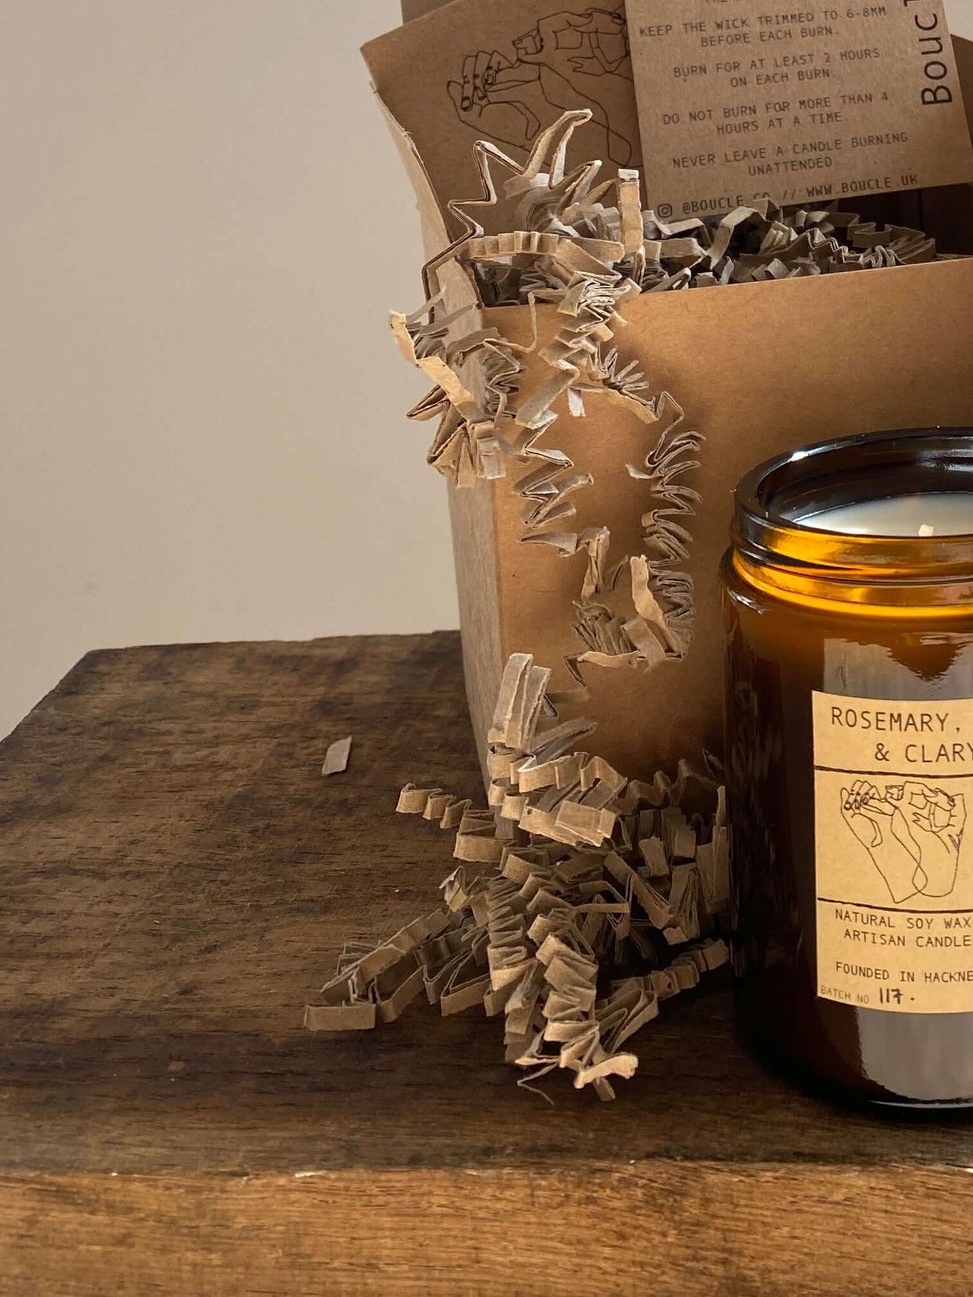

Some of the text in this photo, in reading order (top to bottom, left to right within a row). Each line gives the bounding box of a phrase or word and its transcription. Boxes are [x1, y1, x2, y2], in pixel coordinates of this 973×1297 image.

[639, 6, 886, 37] KEEP THE WICK TRIMMED TO 6-8MM
[700, 33, 751, 47] BEFORE
[759, 30, 792, 43] EACH
[673, 47, 881, 78] BURN FOR AT LEAST 2 HOURS
[730, 76, 748, 88] ON
[756, 73, 789, 86] EACH
[663, 91, 889, 125] DO NOT BURN FOR MORE THAN 4
[717, 121, 760, 135] HOURS
[768, 117, 784, 129] AT
[793, 116, 801, 127] A
[672, 132, 909, 169] NEVER LEAVE A CANDLE BURNING
[806, 175, 919, 198] WWW.BOUCLE.UK
[830, 706, 962, 734] ROSEMARY,
[875, 743, 890, 762] &
[835, 908, 972, 930] NATURAL SOY WAX
[844, 928, 972, 948] ARTISAN CANDLE
[835, 961, 890, 981] FOUNDED
[900, 970, 915, 983] IN
[820, 985, 852, 1001] BATCH
[857, 994, 870, 1005] NO
